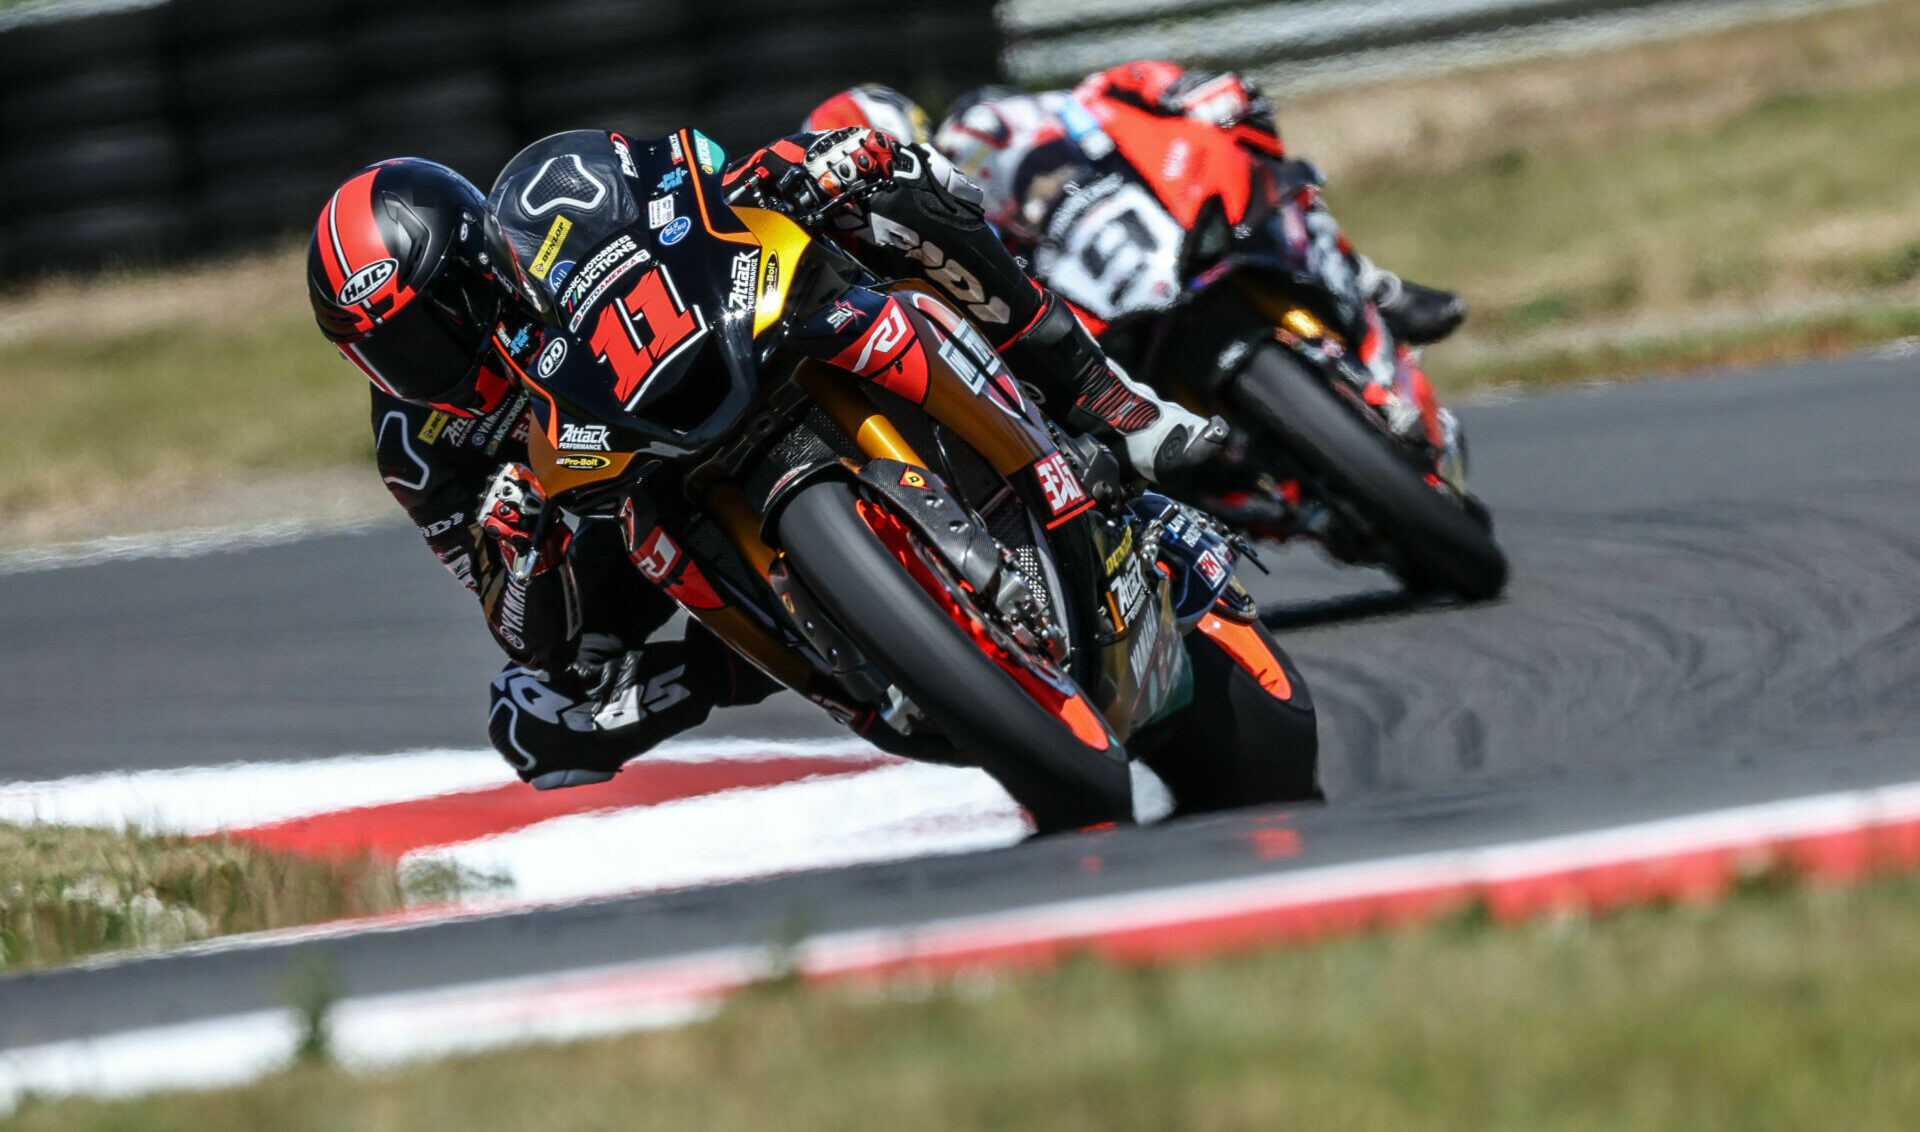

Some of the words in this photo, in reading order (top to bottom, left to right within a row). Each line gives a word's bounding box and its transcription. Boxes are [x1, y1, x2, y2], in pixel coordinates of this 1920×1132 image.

[613, 140, 637, 177] Puig
[542, 221, 564, 262] DUNLOP
[1081, 208, 1158, 307] 9
[344, 263, 387, 302] HJC
[560, 275, 582, 307] ICONIC
[581, 234, 632, 279] MOTORBIKES
[577, 240, 638, 299] AUCTIONS
[580, 258, 637, 314] MOTOAMERICA
[728, 248, 760, 311] Attack
[746, 258, 759, 312] PERFORMANCE
[588, 267, 698, 404] 11
[853, 305, 908, 373] R1
[494, 396, 528, 441] MOTOREX
[558, 424, 611, 451] Attack
[558, 442, 602, 451] PERFORMANCE
[564, 458, 598, 466] Pro-Bolt
[1110, 552, 1148, 617] Attack
